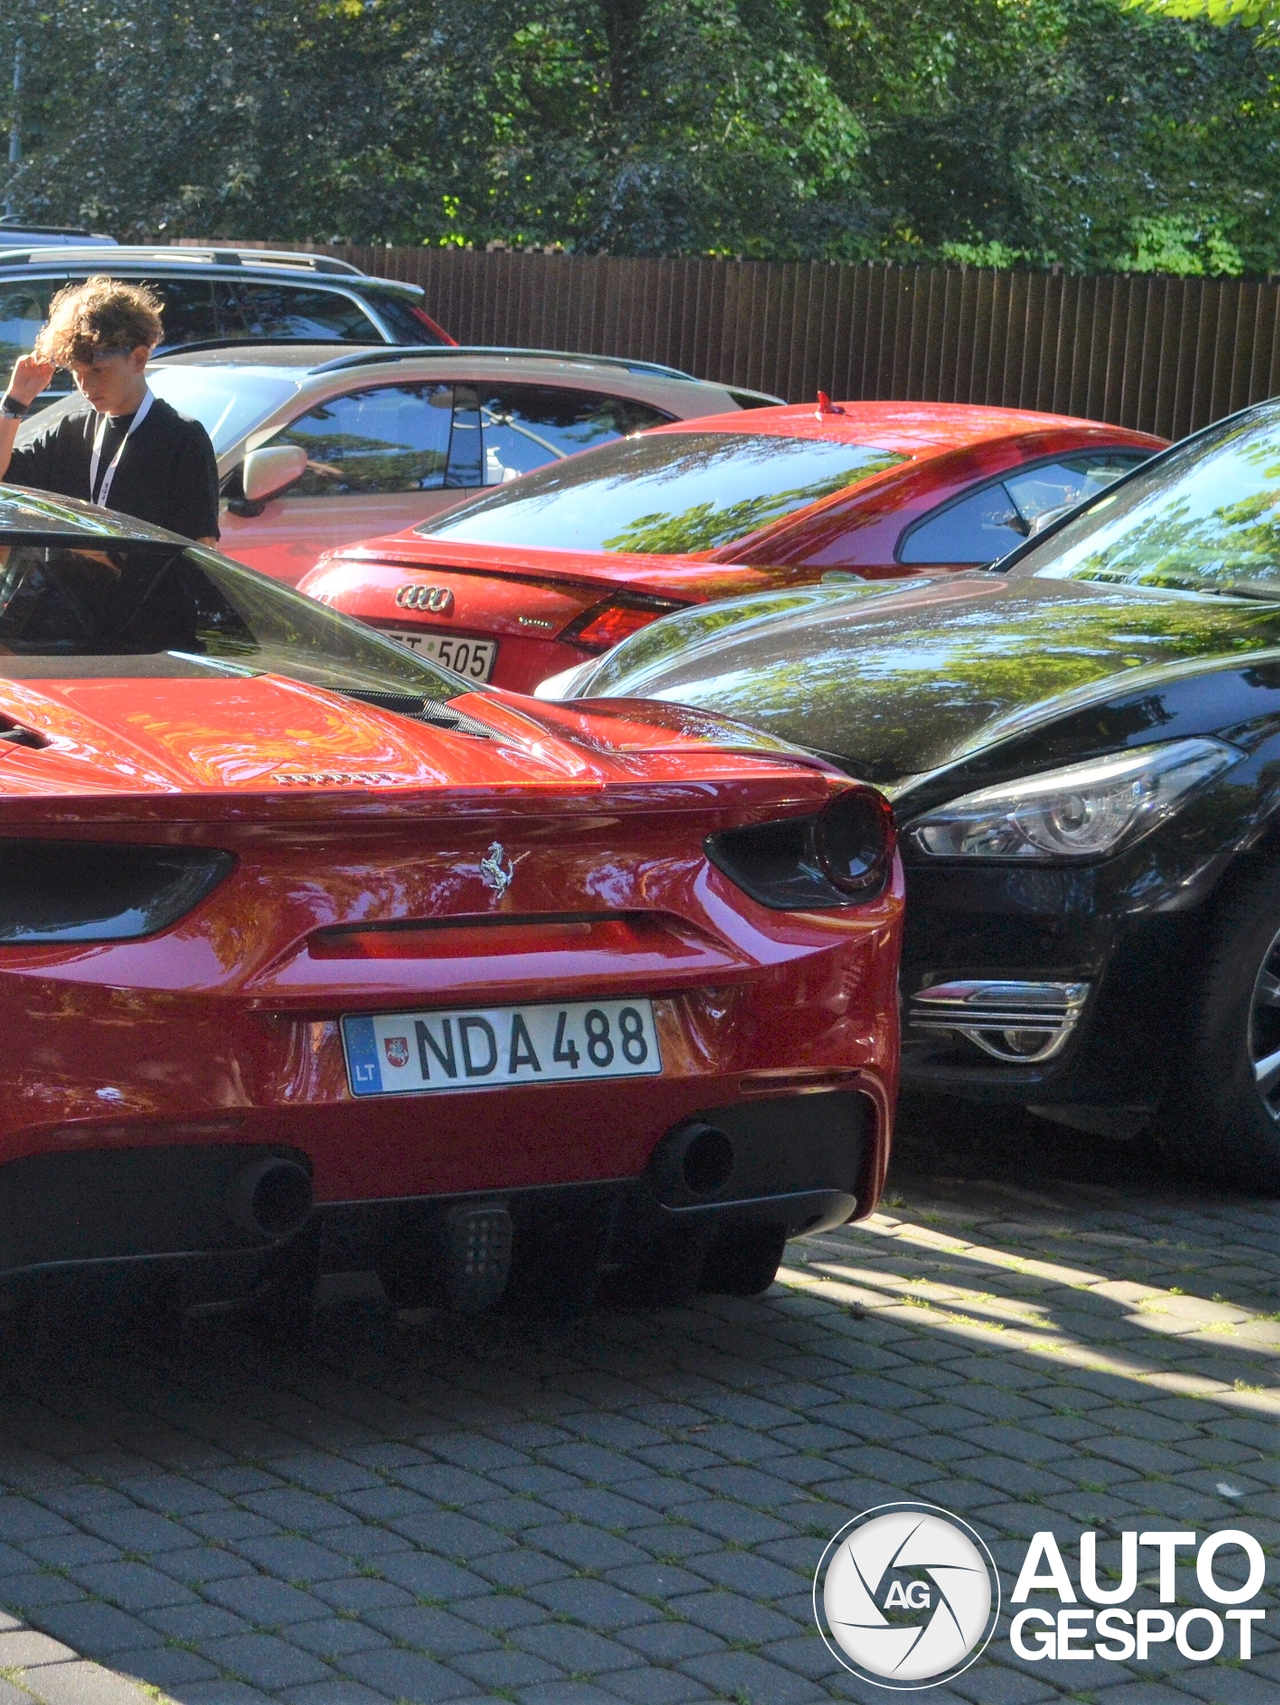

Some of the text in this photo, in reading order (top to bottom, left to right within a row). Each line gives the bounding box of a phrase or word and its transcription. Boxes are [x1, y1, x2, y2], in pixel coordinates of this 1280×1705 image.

[438, 641, 488, 677] 505
[414, 1007, 648, 1081] NDA 488
[355, 1064, 375, 1082] LT
